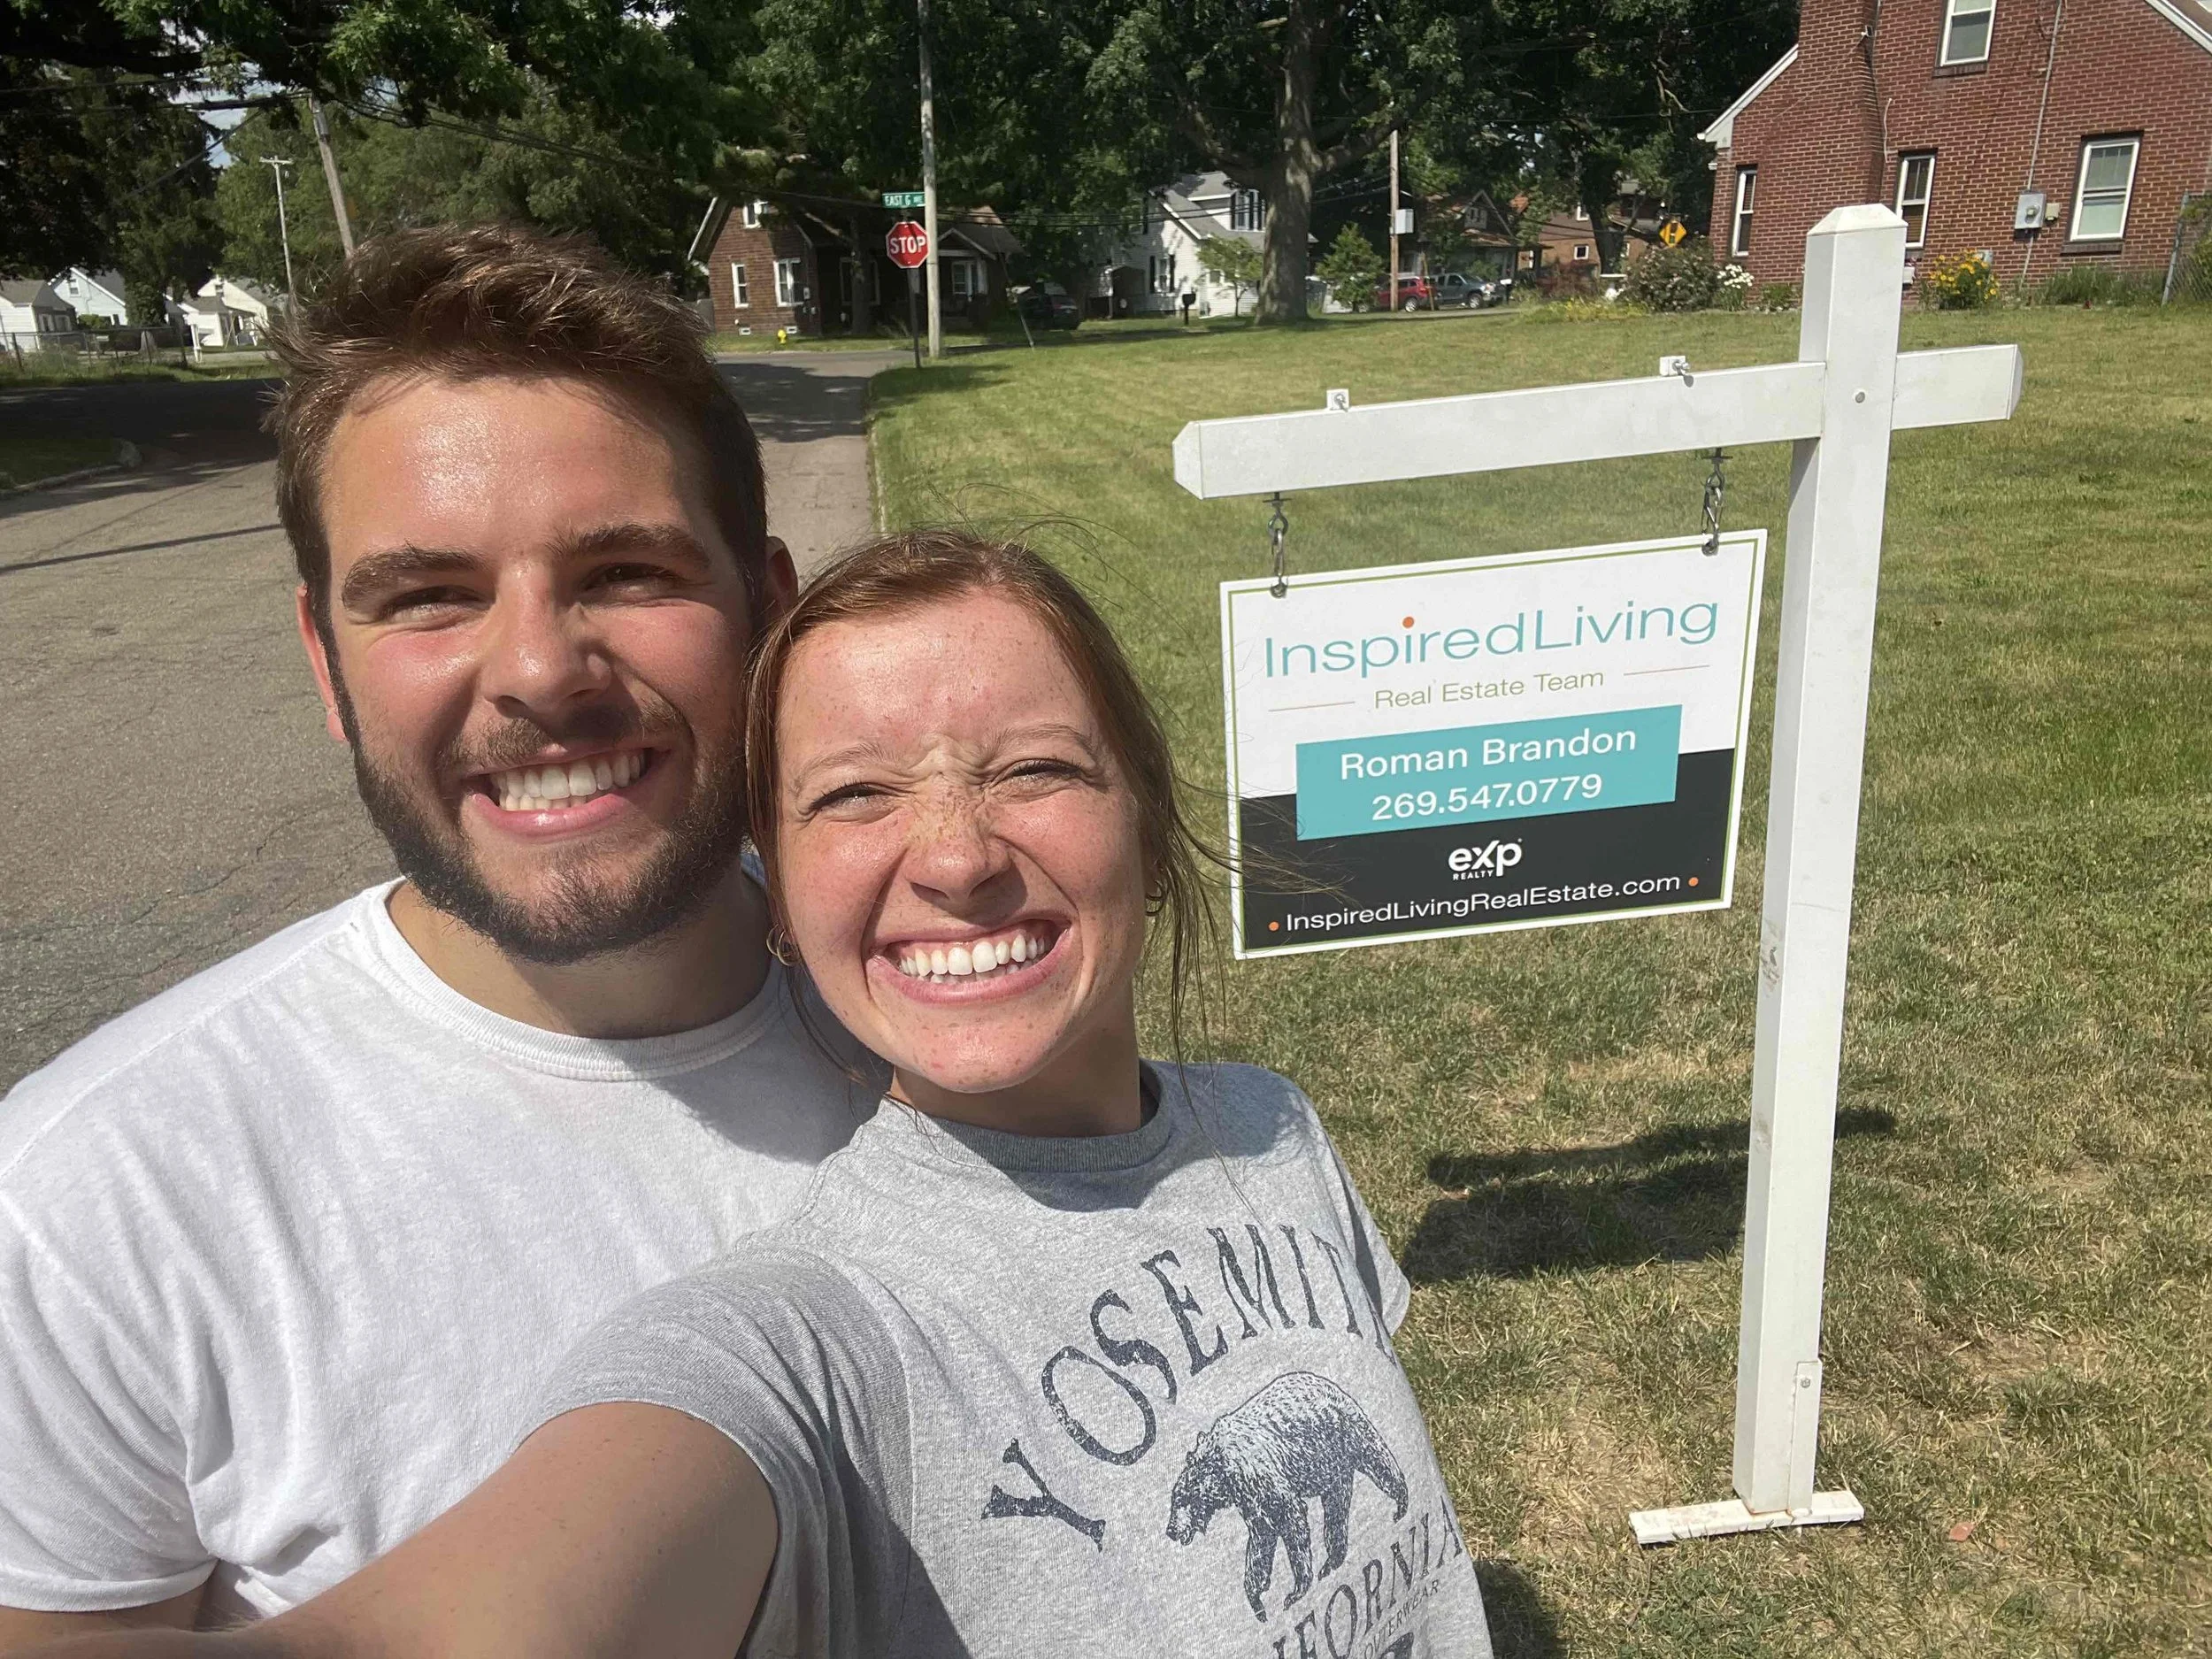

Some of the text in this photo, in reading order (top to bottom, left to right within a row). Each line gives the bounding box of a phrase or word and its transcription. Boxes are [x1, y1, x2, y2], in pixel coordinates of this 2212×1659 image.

[885, 195, 902, 206] EAST
[890, 235, 926, 255] STOP
[1264, 599, 1719, 680] InspiredLiving
[1374, 670, 1605, 710] Real Estate Team
[1340, 727, 1637, 780] Roman Brandon
[1371, 773, 1603, 821] 269.547.0779
[1453, 870, 1494, 880] REALTY
[1286, 875, 1681, 932] InspiredLivingRealEstate.com
